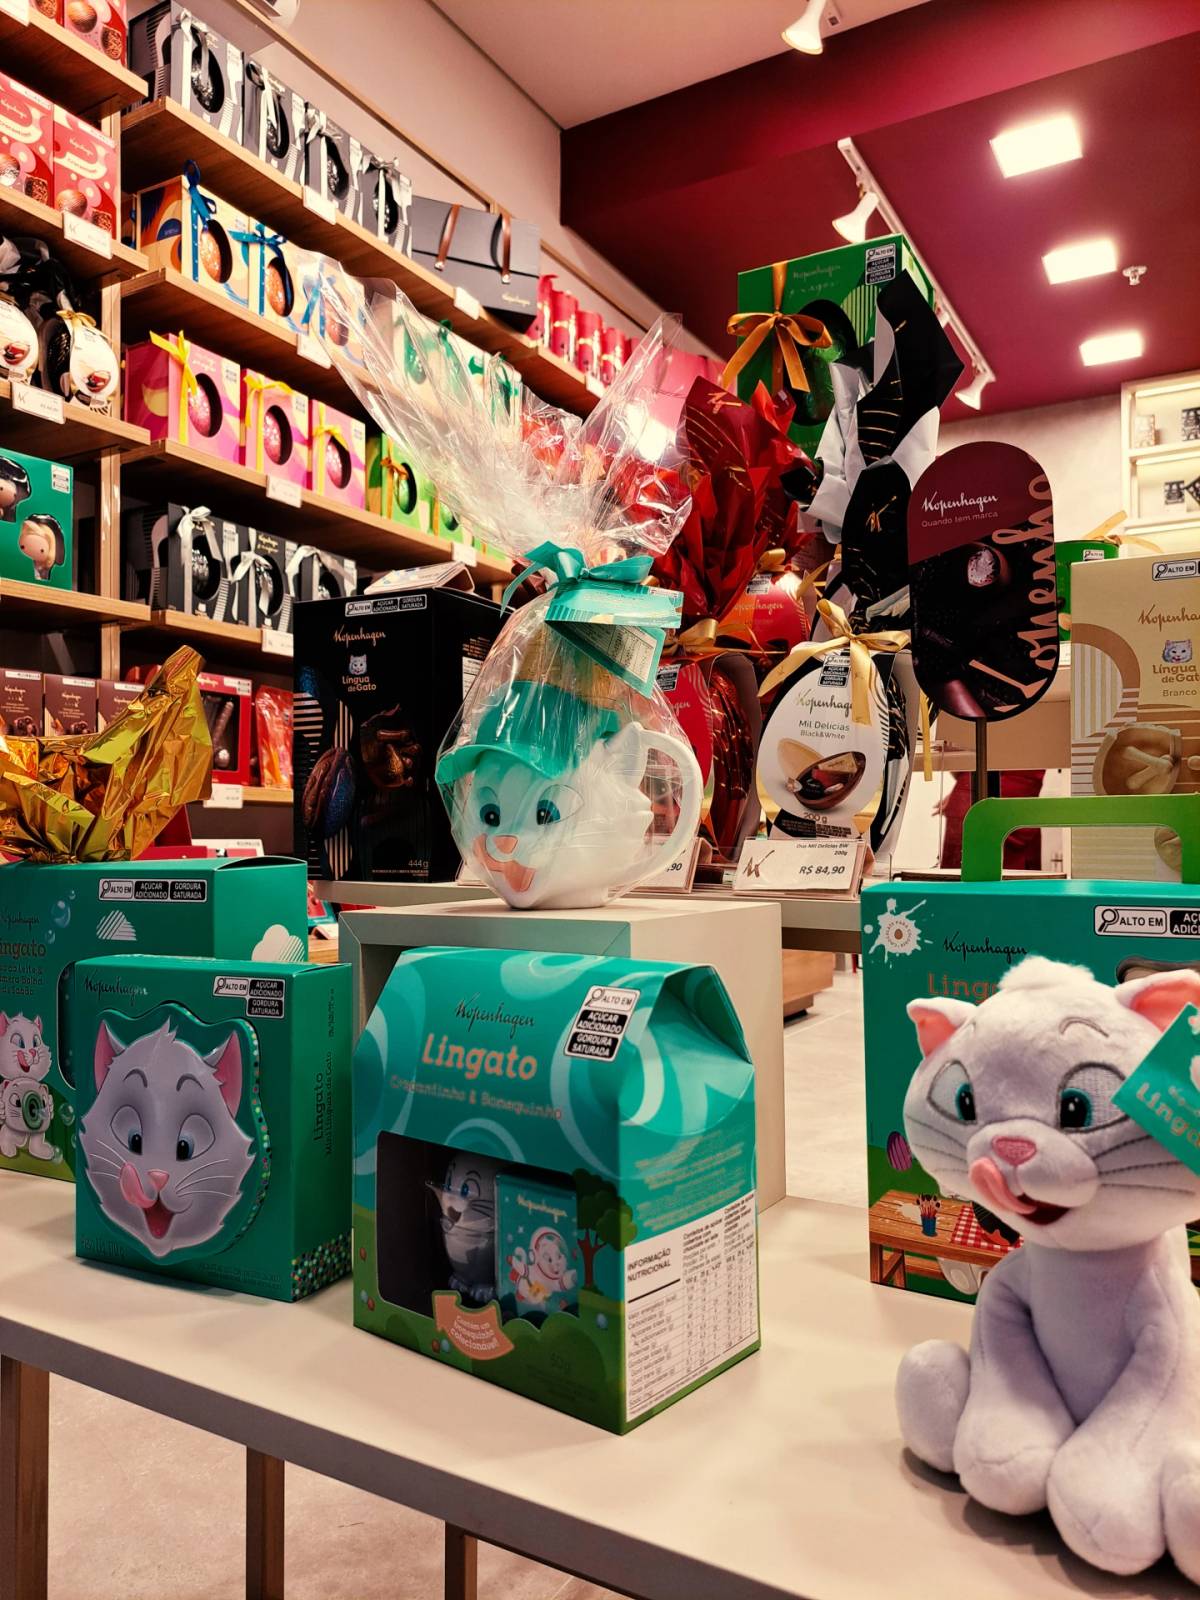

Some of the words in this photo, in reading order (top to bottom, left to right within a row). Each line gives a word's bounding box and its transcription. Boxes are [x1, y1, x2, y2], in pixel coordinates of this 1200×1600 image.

[922, 490, 999, 517] Kopenhagen
[921, 515, 953, 528] Quando
[954, 514, 972, 523] tem
[972, 511, 999, 520] marca
[1167, 566, 1183, 574] ALTO
[1138, 604, 1200, 632] Kopenha
[333, 624, 387, 647] Kopenhagen
[1152, 664, 1197, 675] Língua
[1161, 675, 1175, 683] de
[1175, 672, 1200, 682] Gat
[356, 682, 377, 692] Gato
[1162, 689, 1198, 697] Branco
[795, 688, 853, 718] Kopenhag
[799, 720, 812, 728] Mil
[800, 729, 846, 740] Black&White
[804, 812, 821, 821] 200
[799, 865, 814, 876] R$
[815, 865, 846, 876] 84,90
[110, 885, 124, 893] ALTO
[125, 886, 132, 894] EM
[140, 882, 163, 891] AÇÚCAR
[174, 882, 202, 891] GORDURA
[135, 890, 168, 899] ADICIONADO
[173, 890, 202, 899] SATURADA
[1119, 916, 1146, 926] ALTO
[1148, 917, 1164, 927] EM
[1172, 924, 1200, 934] ADICI
[943, 932, 1028, 963] Kopenhagen
[84, 970, 149, 1006] Kopenhagen
[225, 983, 239, 991] ALTO
[255, 980, 278, 990] AÇÚCAR
[927, 971, 998, 1004] Ling
[250, 989, 283, 998] ADICIONADO
[252, 1000, 279, 1008] GORDURA
[602, 995, 621, 1005] ALTO
[621, 998, 633, 1006] EM
[250, 1007, 280, 1016] SATURADA
[454, 991, 537, 1040] Kopenhagen
[587, 1011, 619, 1024] AÇÚCAR
[577, 1020, 623, 1034] ADICIONADO
[576, 1032, 613, 1046] GORDURA
[571, 1042, 610, 1056] SATURADA
[421, 1032, 538, 1080] Lingato
[313, 1072, 326, 1141] Lingato
[1136, 1082, 1200, 1149] Linga
[627, 1247, 671, 1271] INFORMAÇÃO
[627, 1259, 672, 1282] NUTRICIONAL
